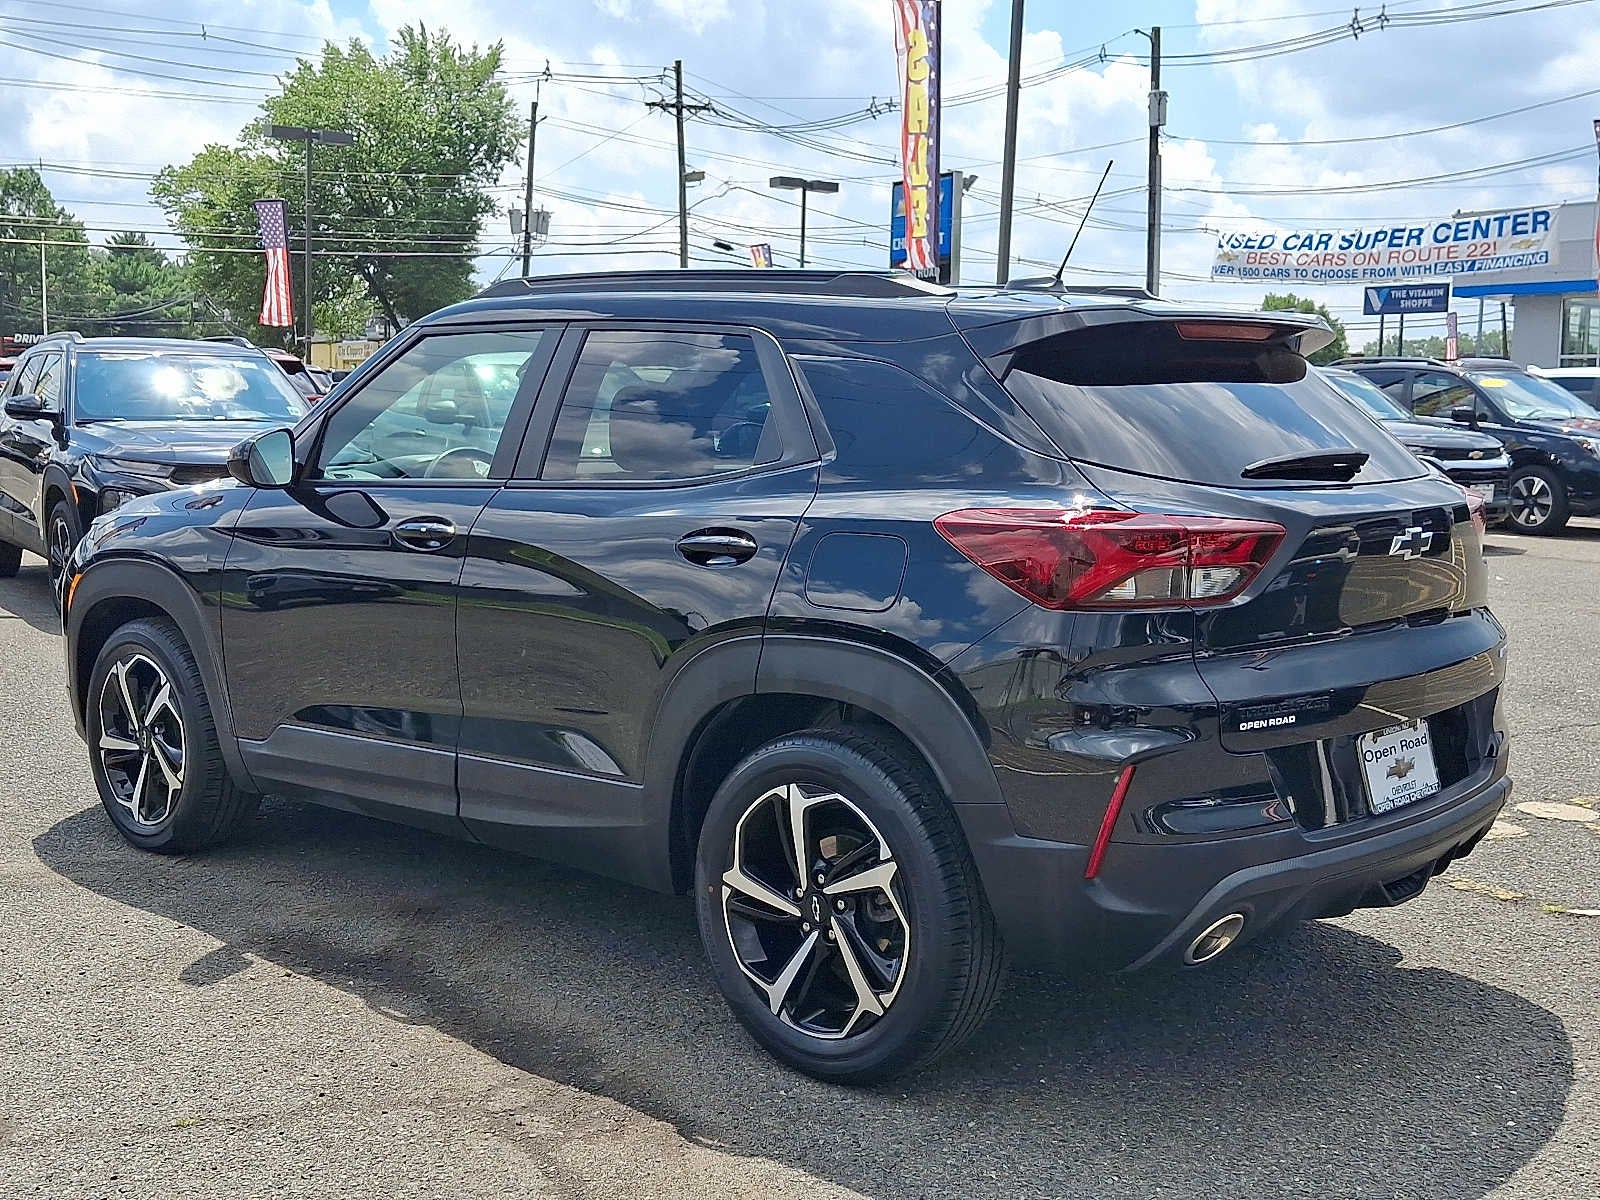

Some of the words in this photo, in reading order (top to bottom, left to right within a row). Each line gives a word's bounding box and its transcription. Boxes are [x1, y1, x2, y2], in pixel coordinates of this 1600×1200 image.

[1218, 231, 1275, 250] USED
[1283, 233, 1333, 251] CAR
[1338, 228, 1424, 251] SUPER
[1432, 210, 1551, 244] CENTER
[1246, 252, 1293, 266] BEST
[1296, 252, 1347, 267] CARS
[1353, 252, 1381, 266] ON
[1388, 244, 1459, 264] ROUTE
[1466, 241, 1498, 258] 22!
[1212, 264, 1235, 275] VER
[1238, 267, 1260, 278] 1500
[1262, 267, 1291, 278] CARS
[1294, 268, 1309, 278] TO
[1310, 268, 1359, 279] CHOOSE
[1362, 267, 1397, 278] FROM
[1401, 264, 1435, 277] WITH
[1436, 260, 1475, 275] EASY
[1474, 252, 1547, 271] FINANCING
[1390, 289, 1407, 299] THE
[1408, 288, 1444, 298] VITAMIN
[1400, 299, 1433, 308] SHOPPE
[1239, 719, 1268, 731] OPEN
[1268, 715, 1296, 727] ROAD
[1363, 745, 1397, 763] Open
[1399, 733, 1428, 752] Road
[1377, 802, 1395, 813] OPEN
